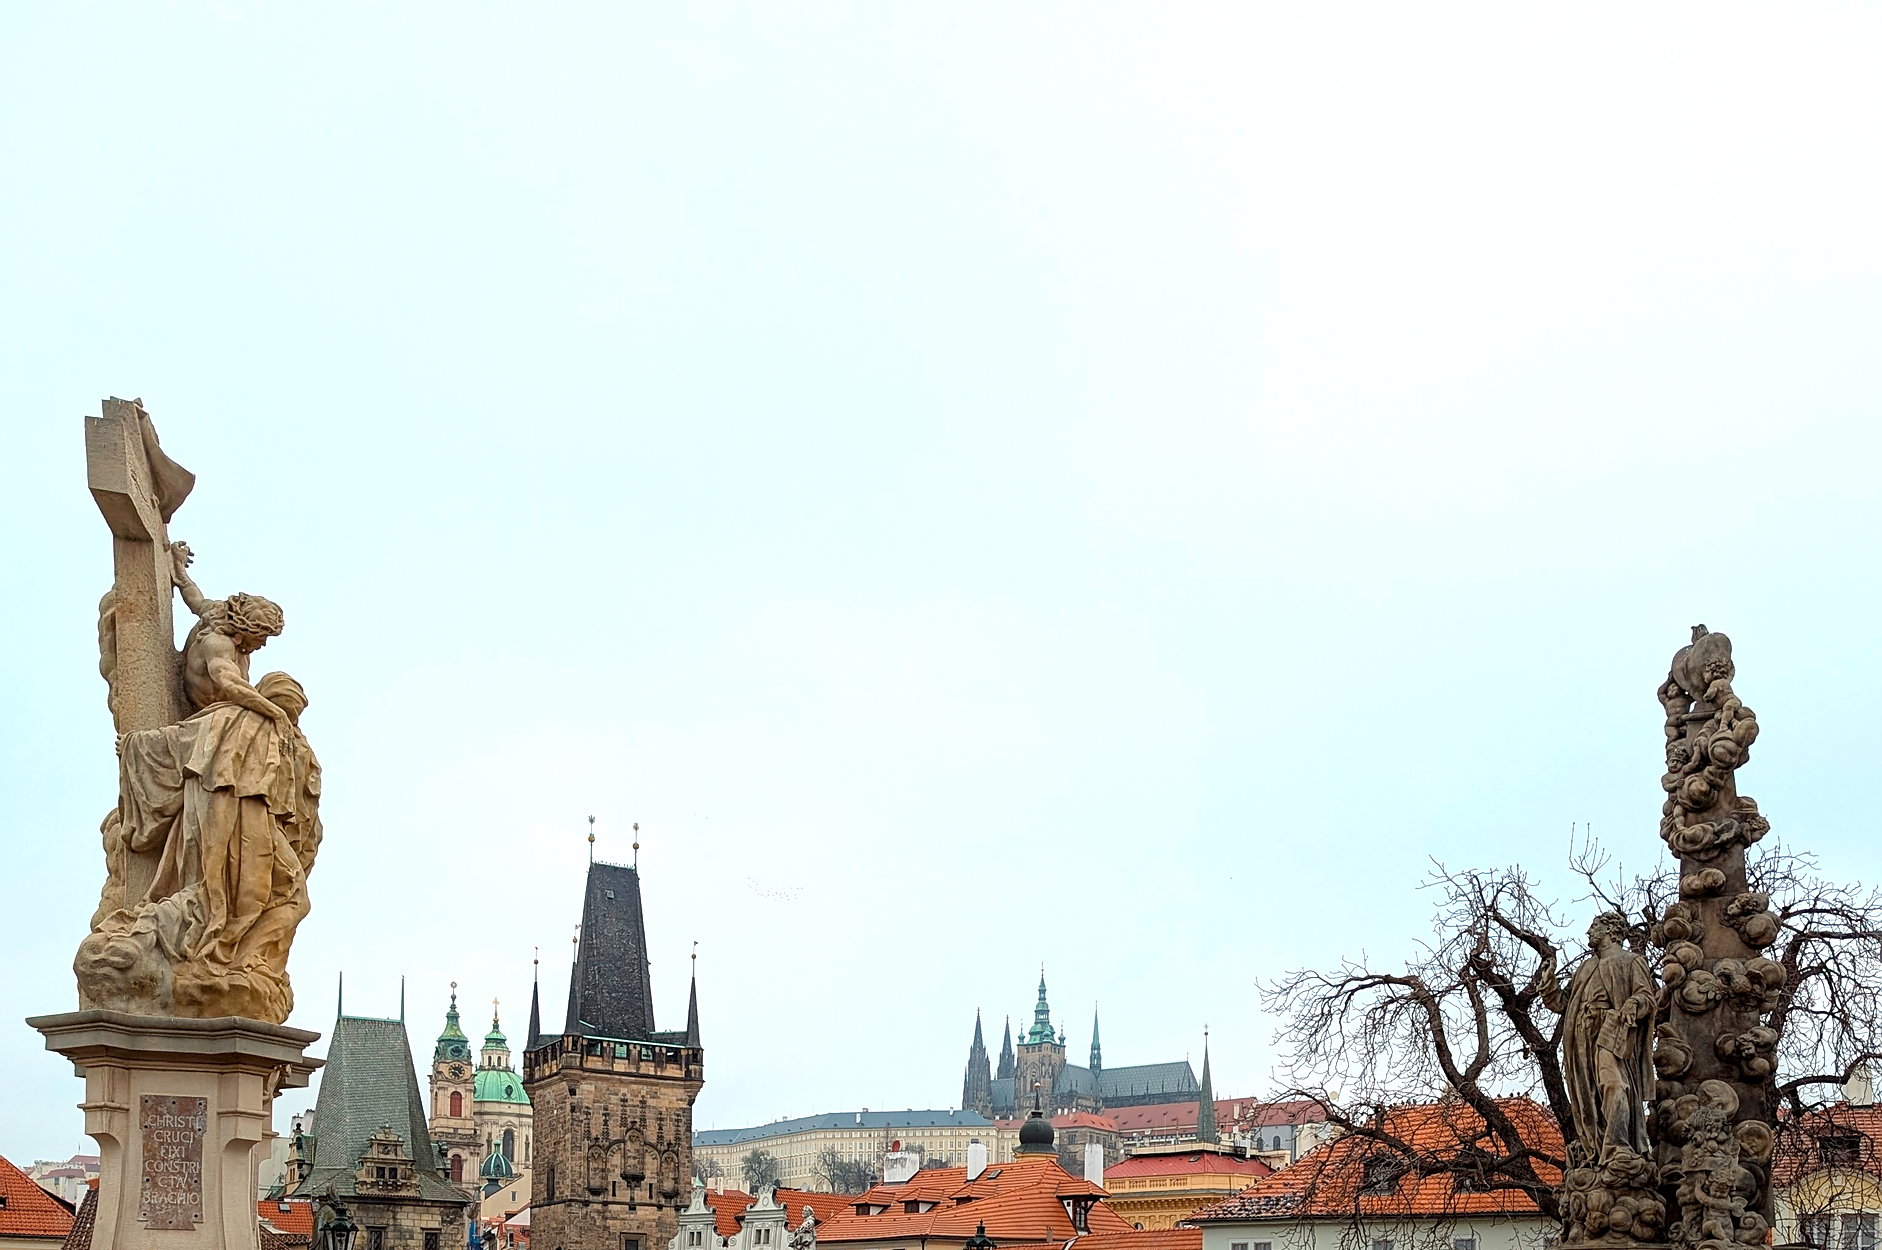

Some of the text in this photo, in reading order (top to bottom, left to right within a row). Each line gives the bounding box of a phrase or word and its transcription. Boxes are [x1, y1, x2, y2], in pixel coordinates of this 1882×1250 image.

[153, 1130, 194, 1143] CRUCI
[145, 1160, 200, 1173] CONSTRI
[143, 1191, 199, 1204] BRACHIO
